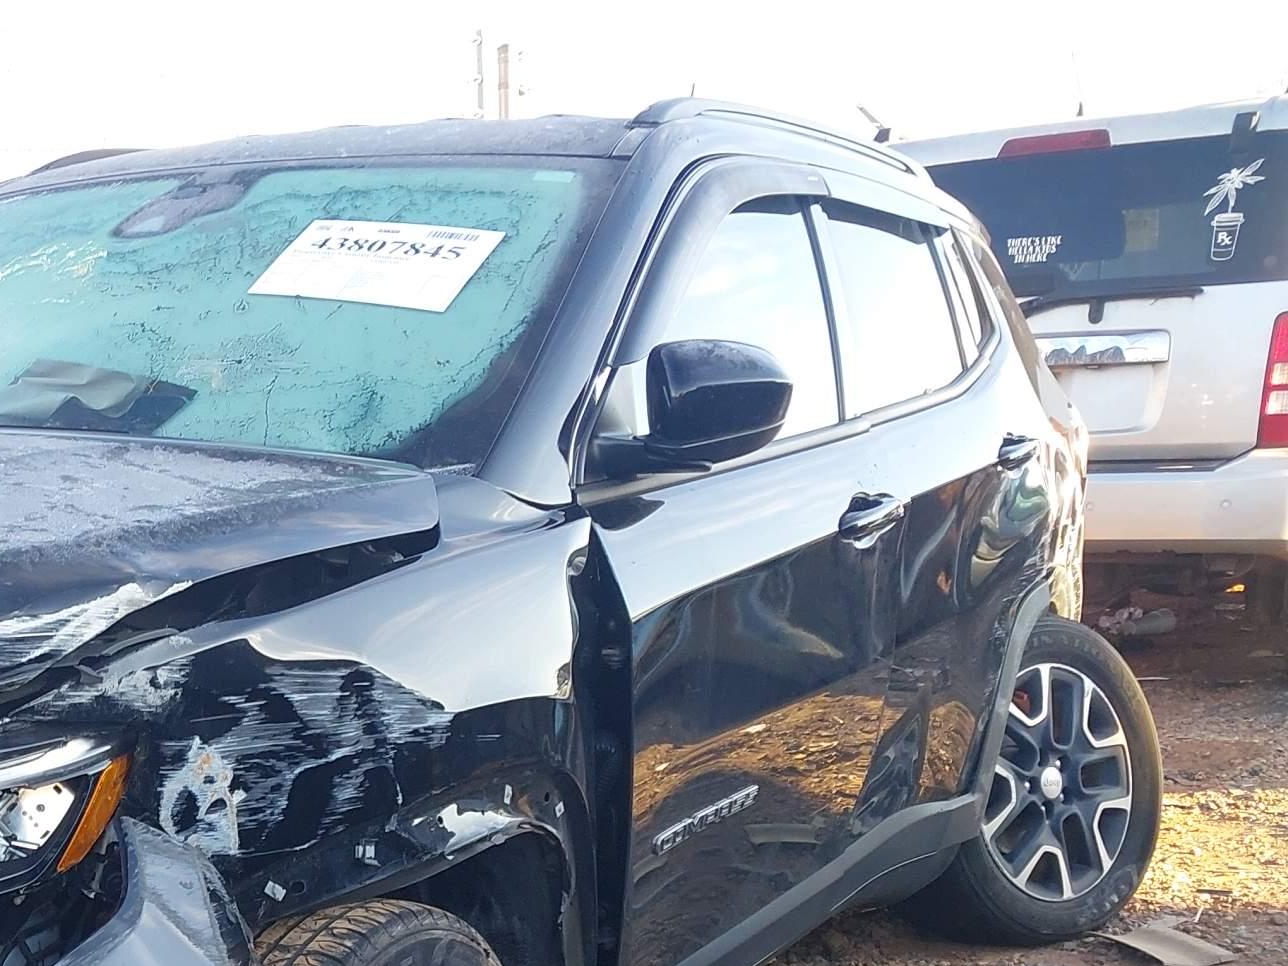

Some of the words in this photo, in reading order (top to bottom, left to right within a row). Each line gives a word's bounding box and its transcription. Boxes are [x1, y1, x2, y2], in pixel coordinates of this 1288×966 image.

[1007, 236, 1040, 247] THERE'S
[1041, 235, 1062, 245] LIKE
[311, 236, 466, 260] 43807845
[1008, 246, 1034, 256] HELLA
[1034, 244, 1057, 254] KIDS
[1014, 254, 1026, 264] IN
[1025, 253, 1048, 263] HERE
